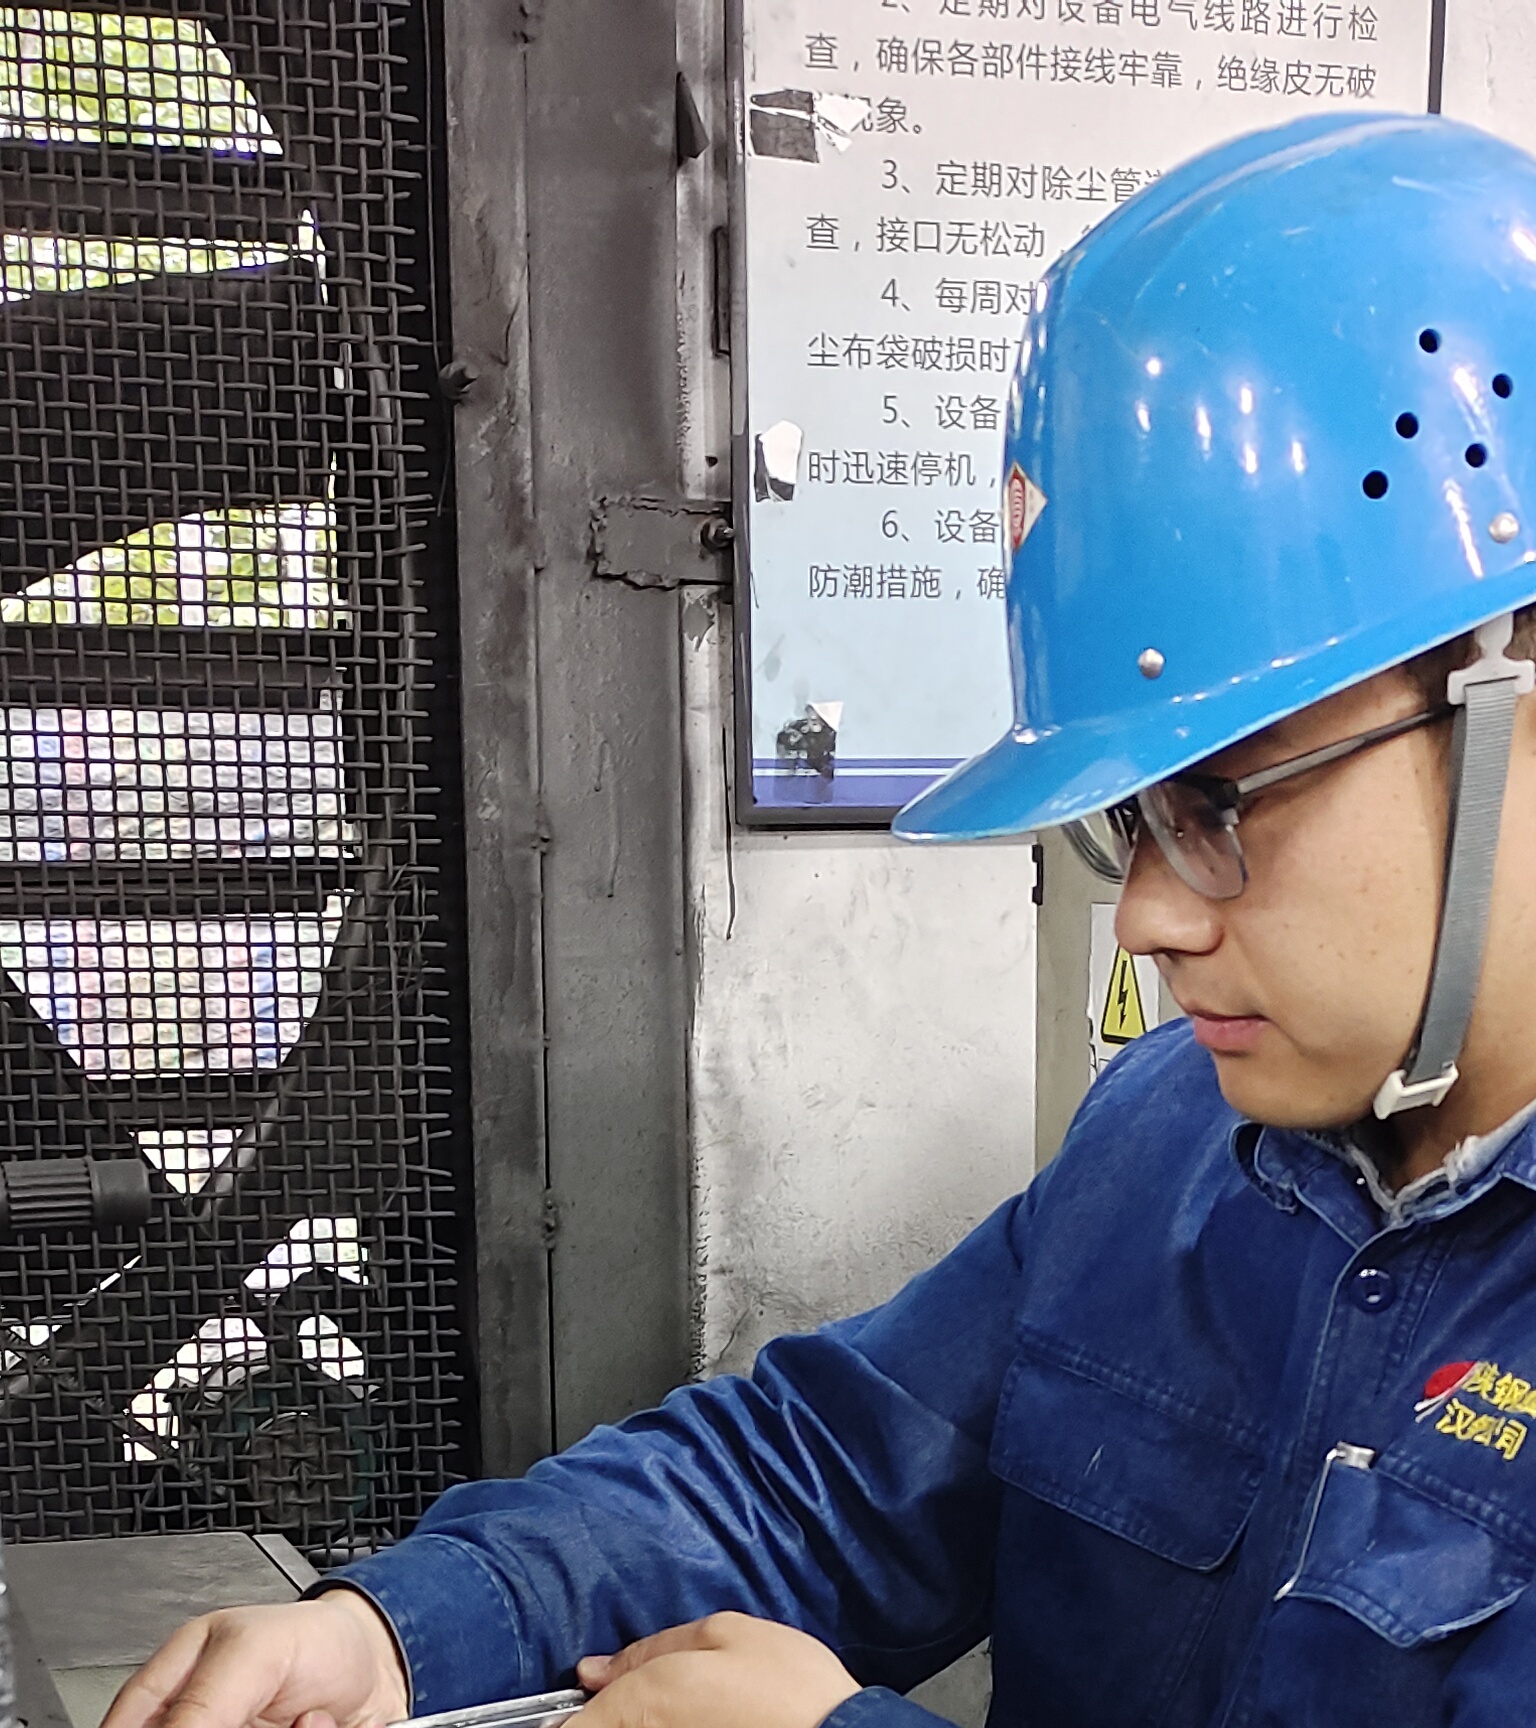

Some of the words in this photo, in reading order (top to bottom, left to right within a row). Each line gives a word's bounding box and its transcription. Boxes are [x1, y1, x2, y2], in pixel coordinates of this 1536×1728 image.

[882, 0, 1379, 42] 、期对设备电气线路进行检
[881, 158, 1161, 203] 3、定期对除尘管
[805, 213, 1090, 259] 查，接口无松动
[807, 332, 1021, 372] 尘布袋破损时
[882, 394, 1001, 430] 5、设备
[808, 450, 997, 488] 时迅速停机，
[881, 509, 1000, 544] 6、设备
